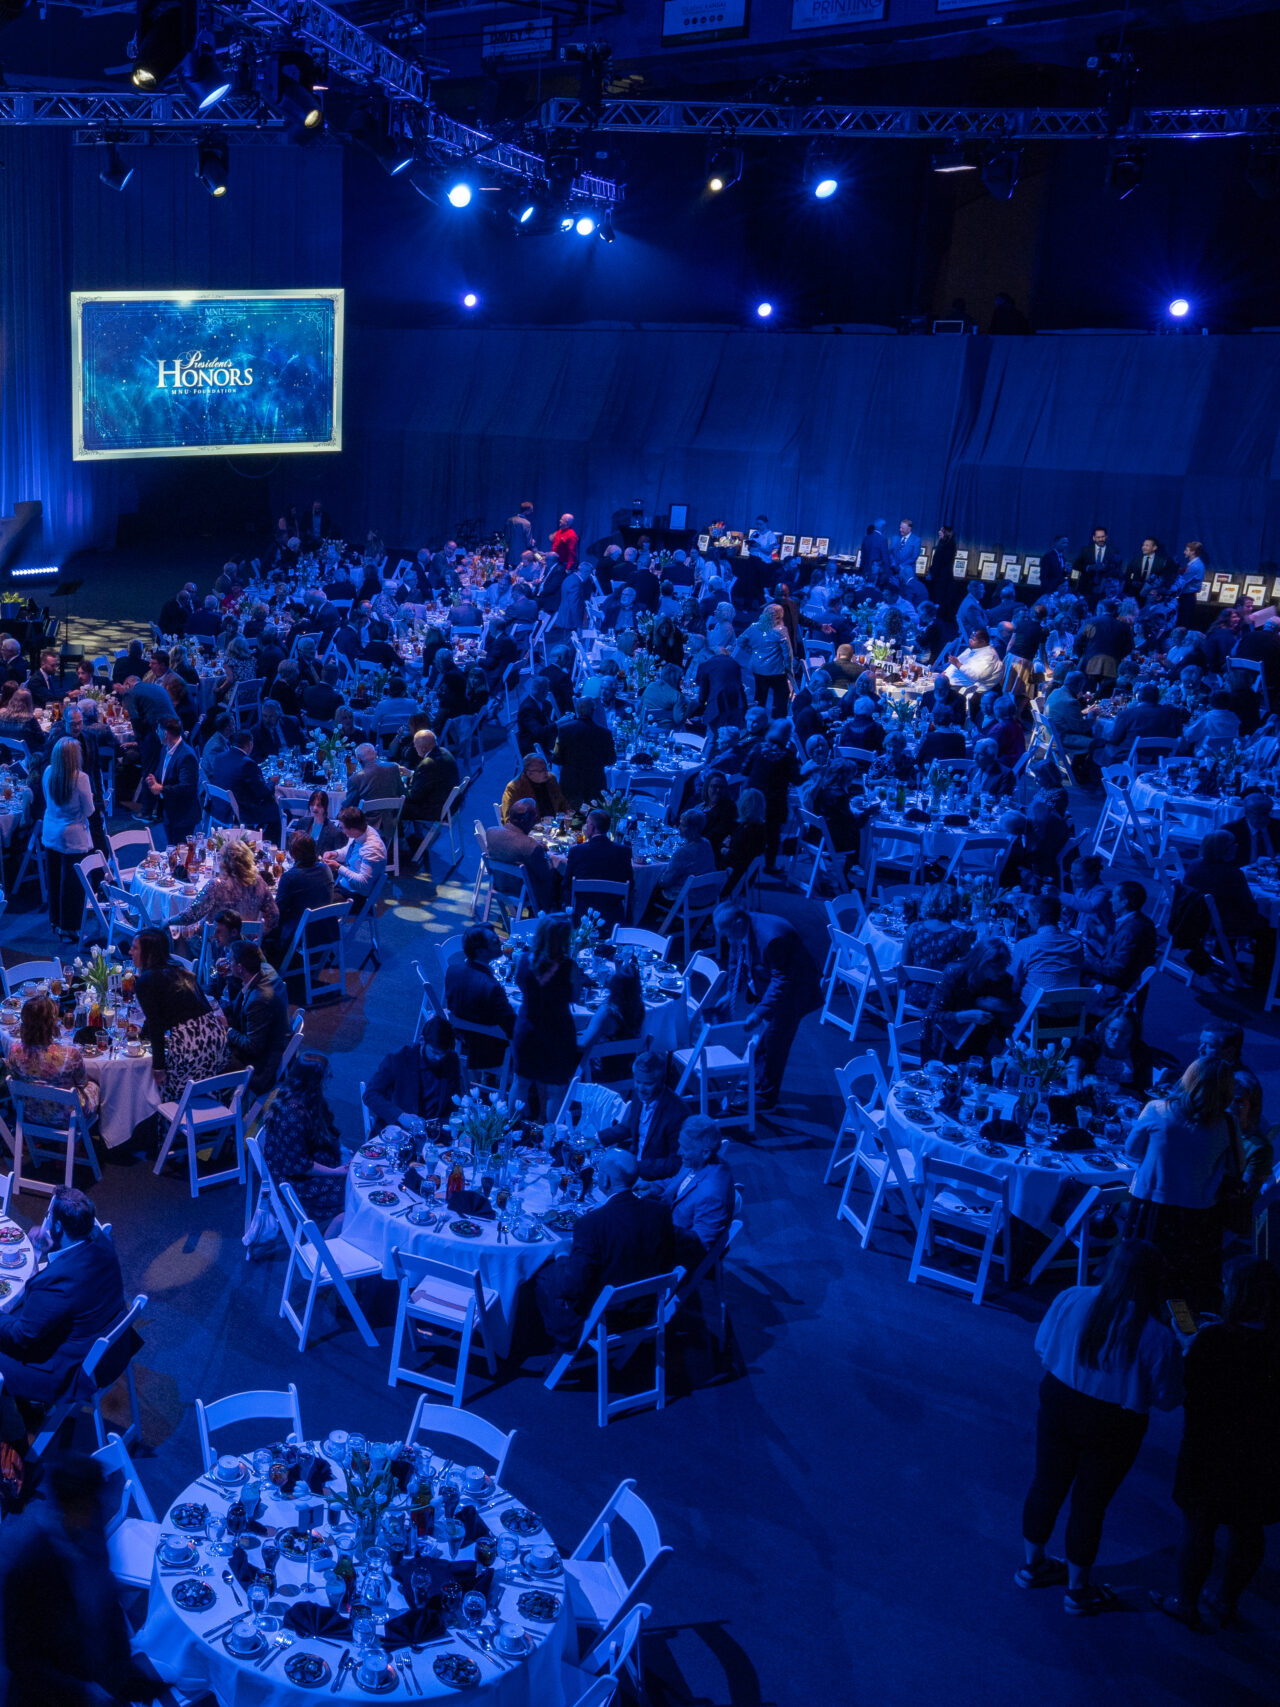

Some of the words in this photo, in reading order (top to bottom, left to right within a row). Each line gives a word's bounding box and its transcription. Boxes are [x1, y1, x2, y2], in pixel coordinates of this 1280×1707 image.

[177, 350, 233, 370] President's
[157, 360, 253, 388] HONORS
[1024, 1077, 1035, 1088] 13
[310, 1510, 314, 1524] 1
